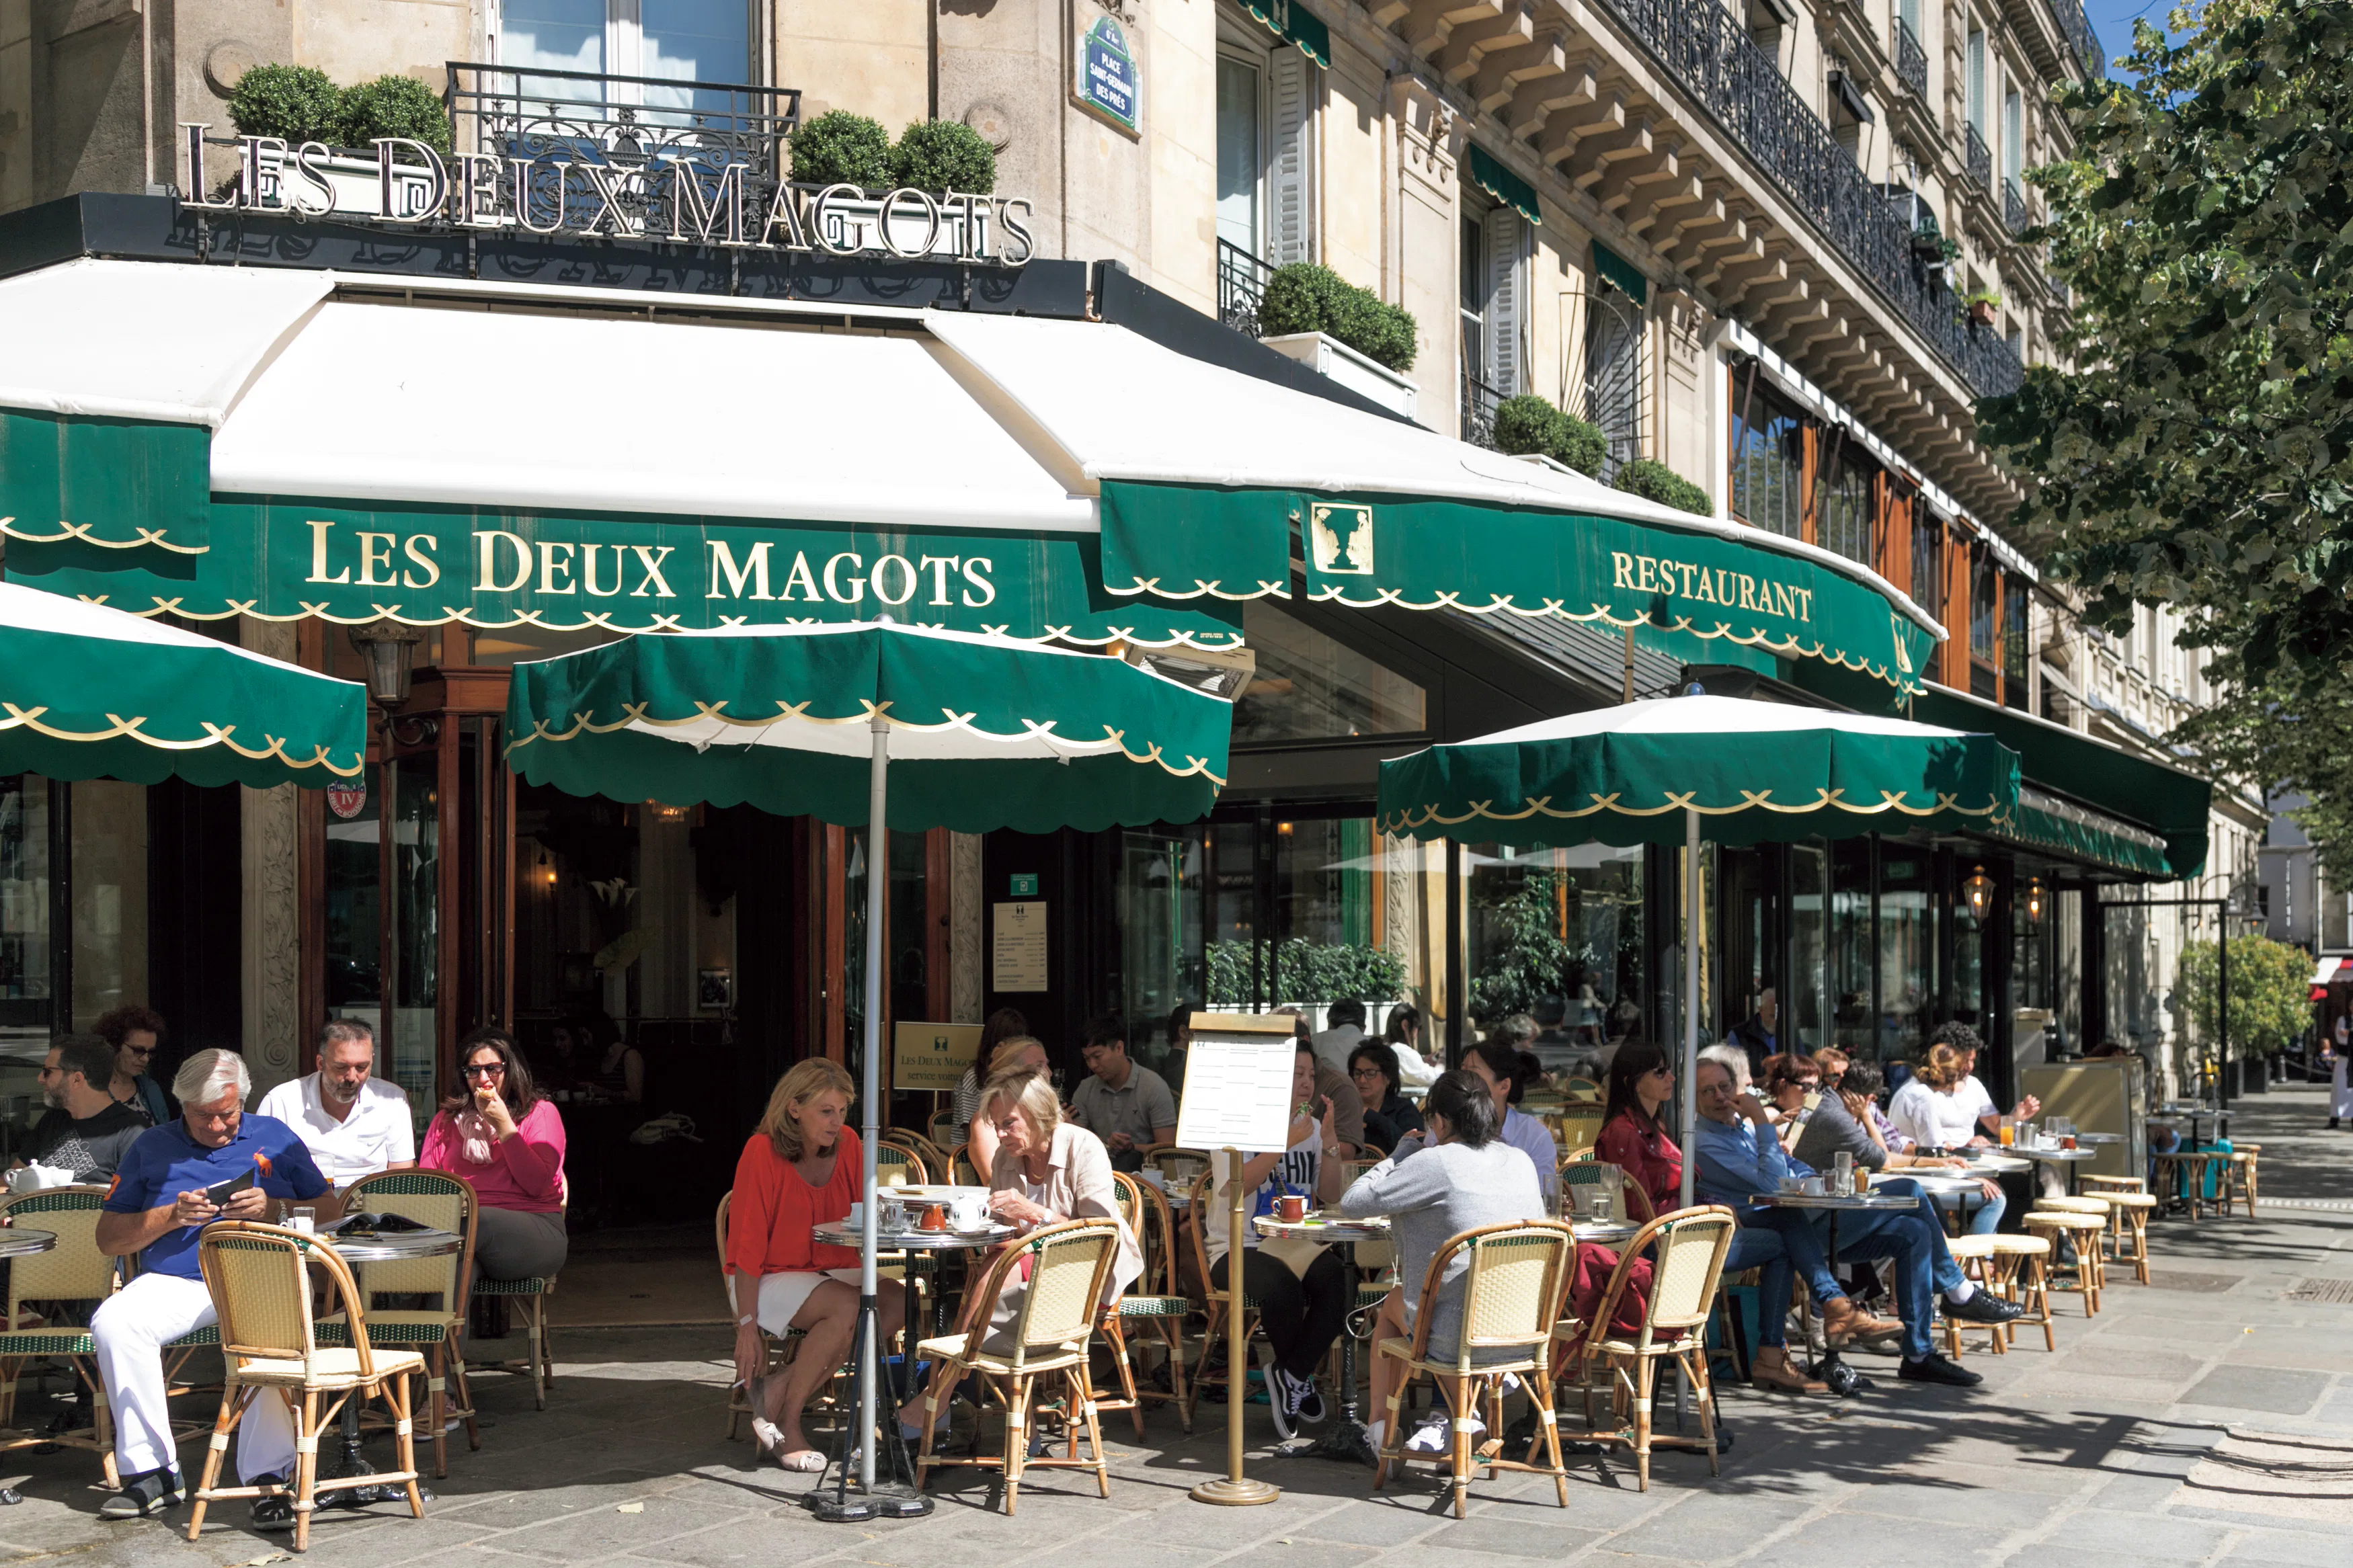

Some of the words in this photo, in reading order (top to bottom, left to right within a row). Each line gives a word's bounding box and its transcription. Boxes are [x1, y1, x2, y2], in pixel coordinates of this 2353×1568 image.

[1101, 52, 1121, 75] PLACE
[1096, 83, 1109, 100] DES
[178, 122, 336, 216] LES
[370, 137, 647, 239] DEUX
[666, 159, 1035, 267] MAGOTS
[305, 520, 440, 589] LES
[472, 530, 677, 597] DEUX
[705, 540, 996, 608] MAGOTS
[1611, 552, 1812, 622] RESTAURANT
[341, 793, 356, 805] IV
[343, 793, 364, 816] BOISSONS
[901, 1055, 916, 1065] LES
[918, 1056, 942, 1066] DEUX
[908, 1070, 936, 1080] service
